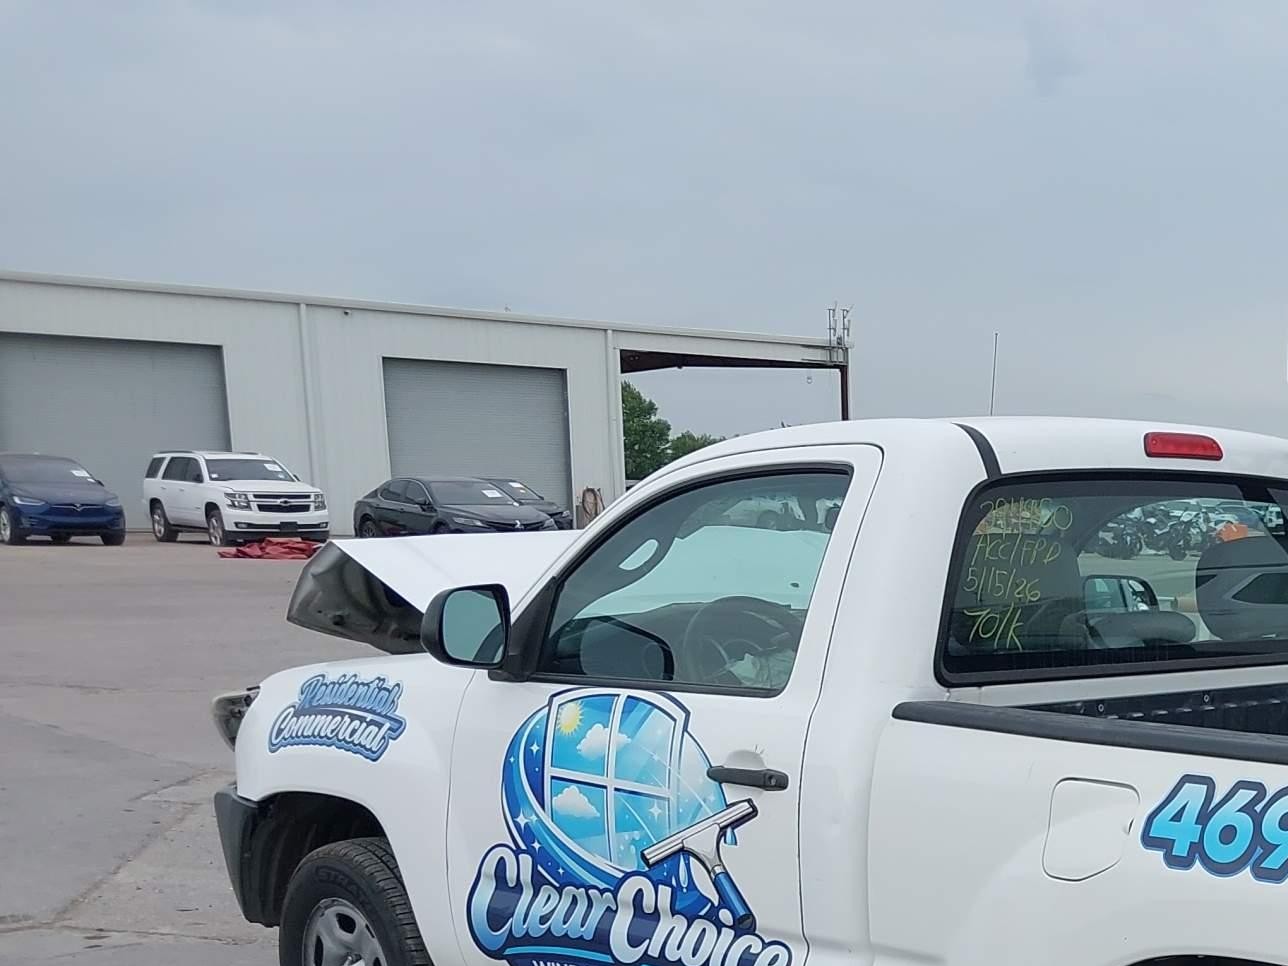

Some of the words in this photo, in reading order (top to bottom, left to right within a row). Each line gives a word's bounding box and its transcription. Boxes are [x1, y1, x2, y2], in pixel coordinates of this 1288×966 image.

[963, 566, 1041, 602] 5/15/26
[301, 674, 400, 714] Residential
[271, 707, 389, 752] Commercial
[471, 845, 617, 950] Clear
